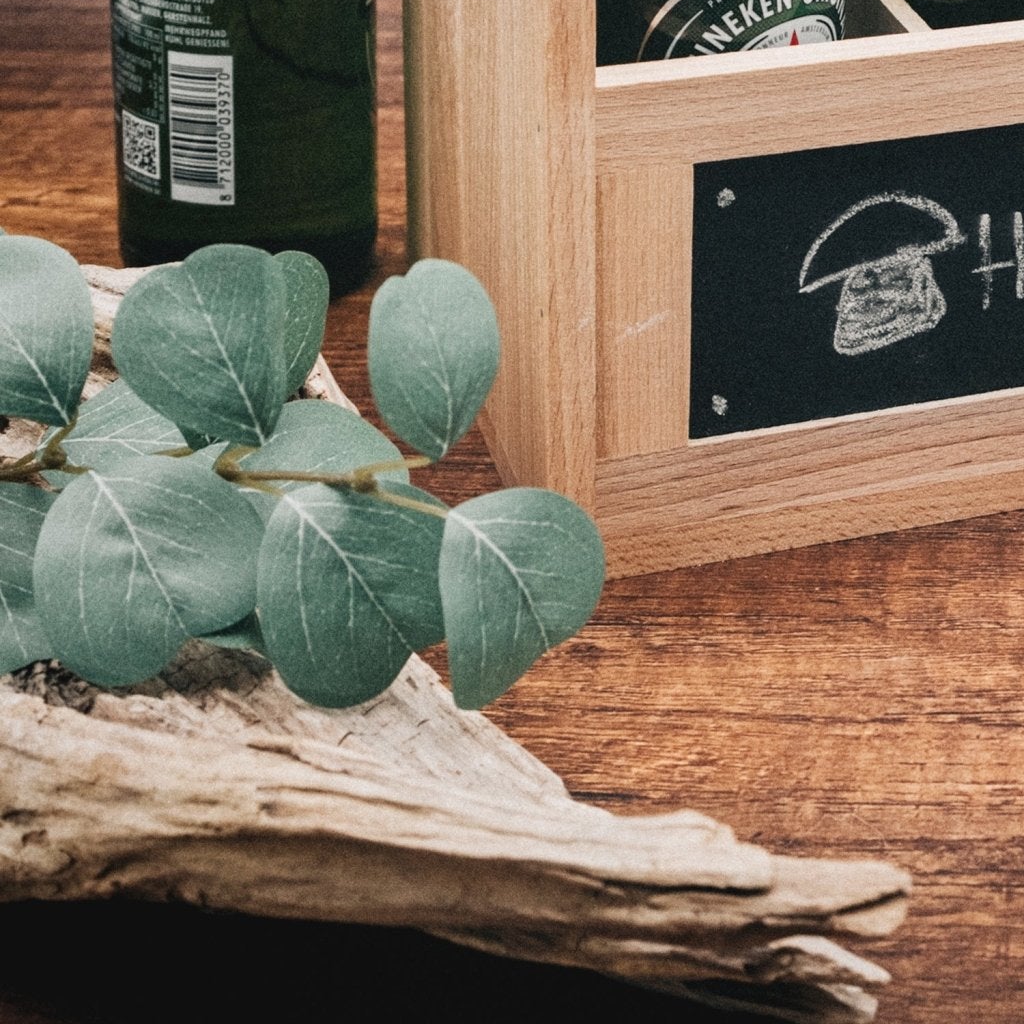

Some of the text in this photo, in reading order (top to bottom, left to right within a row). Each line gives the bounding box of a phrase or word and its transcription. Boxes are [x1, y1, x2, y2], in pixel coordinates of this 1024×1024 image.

[217, 72, 232, 202] 8 712000 039370
